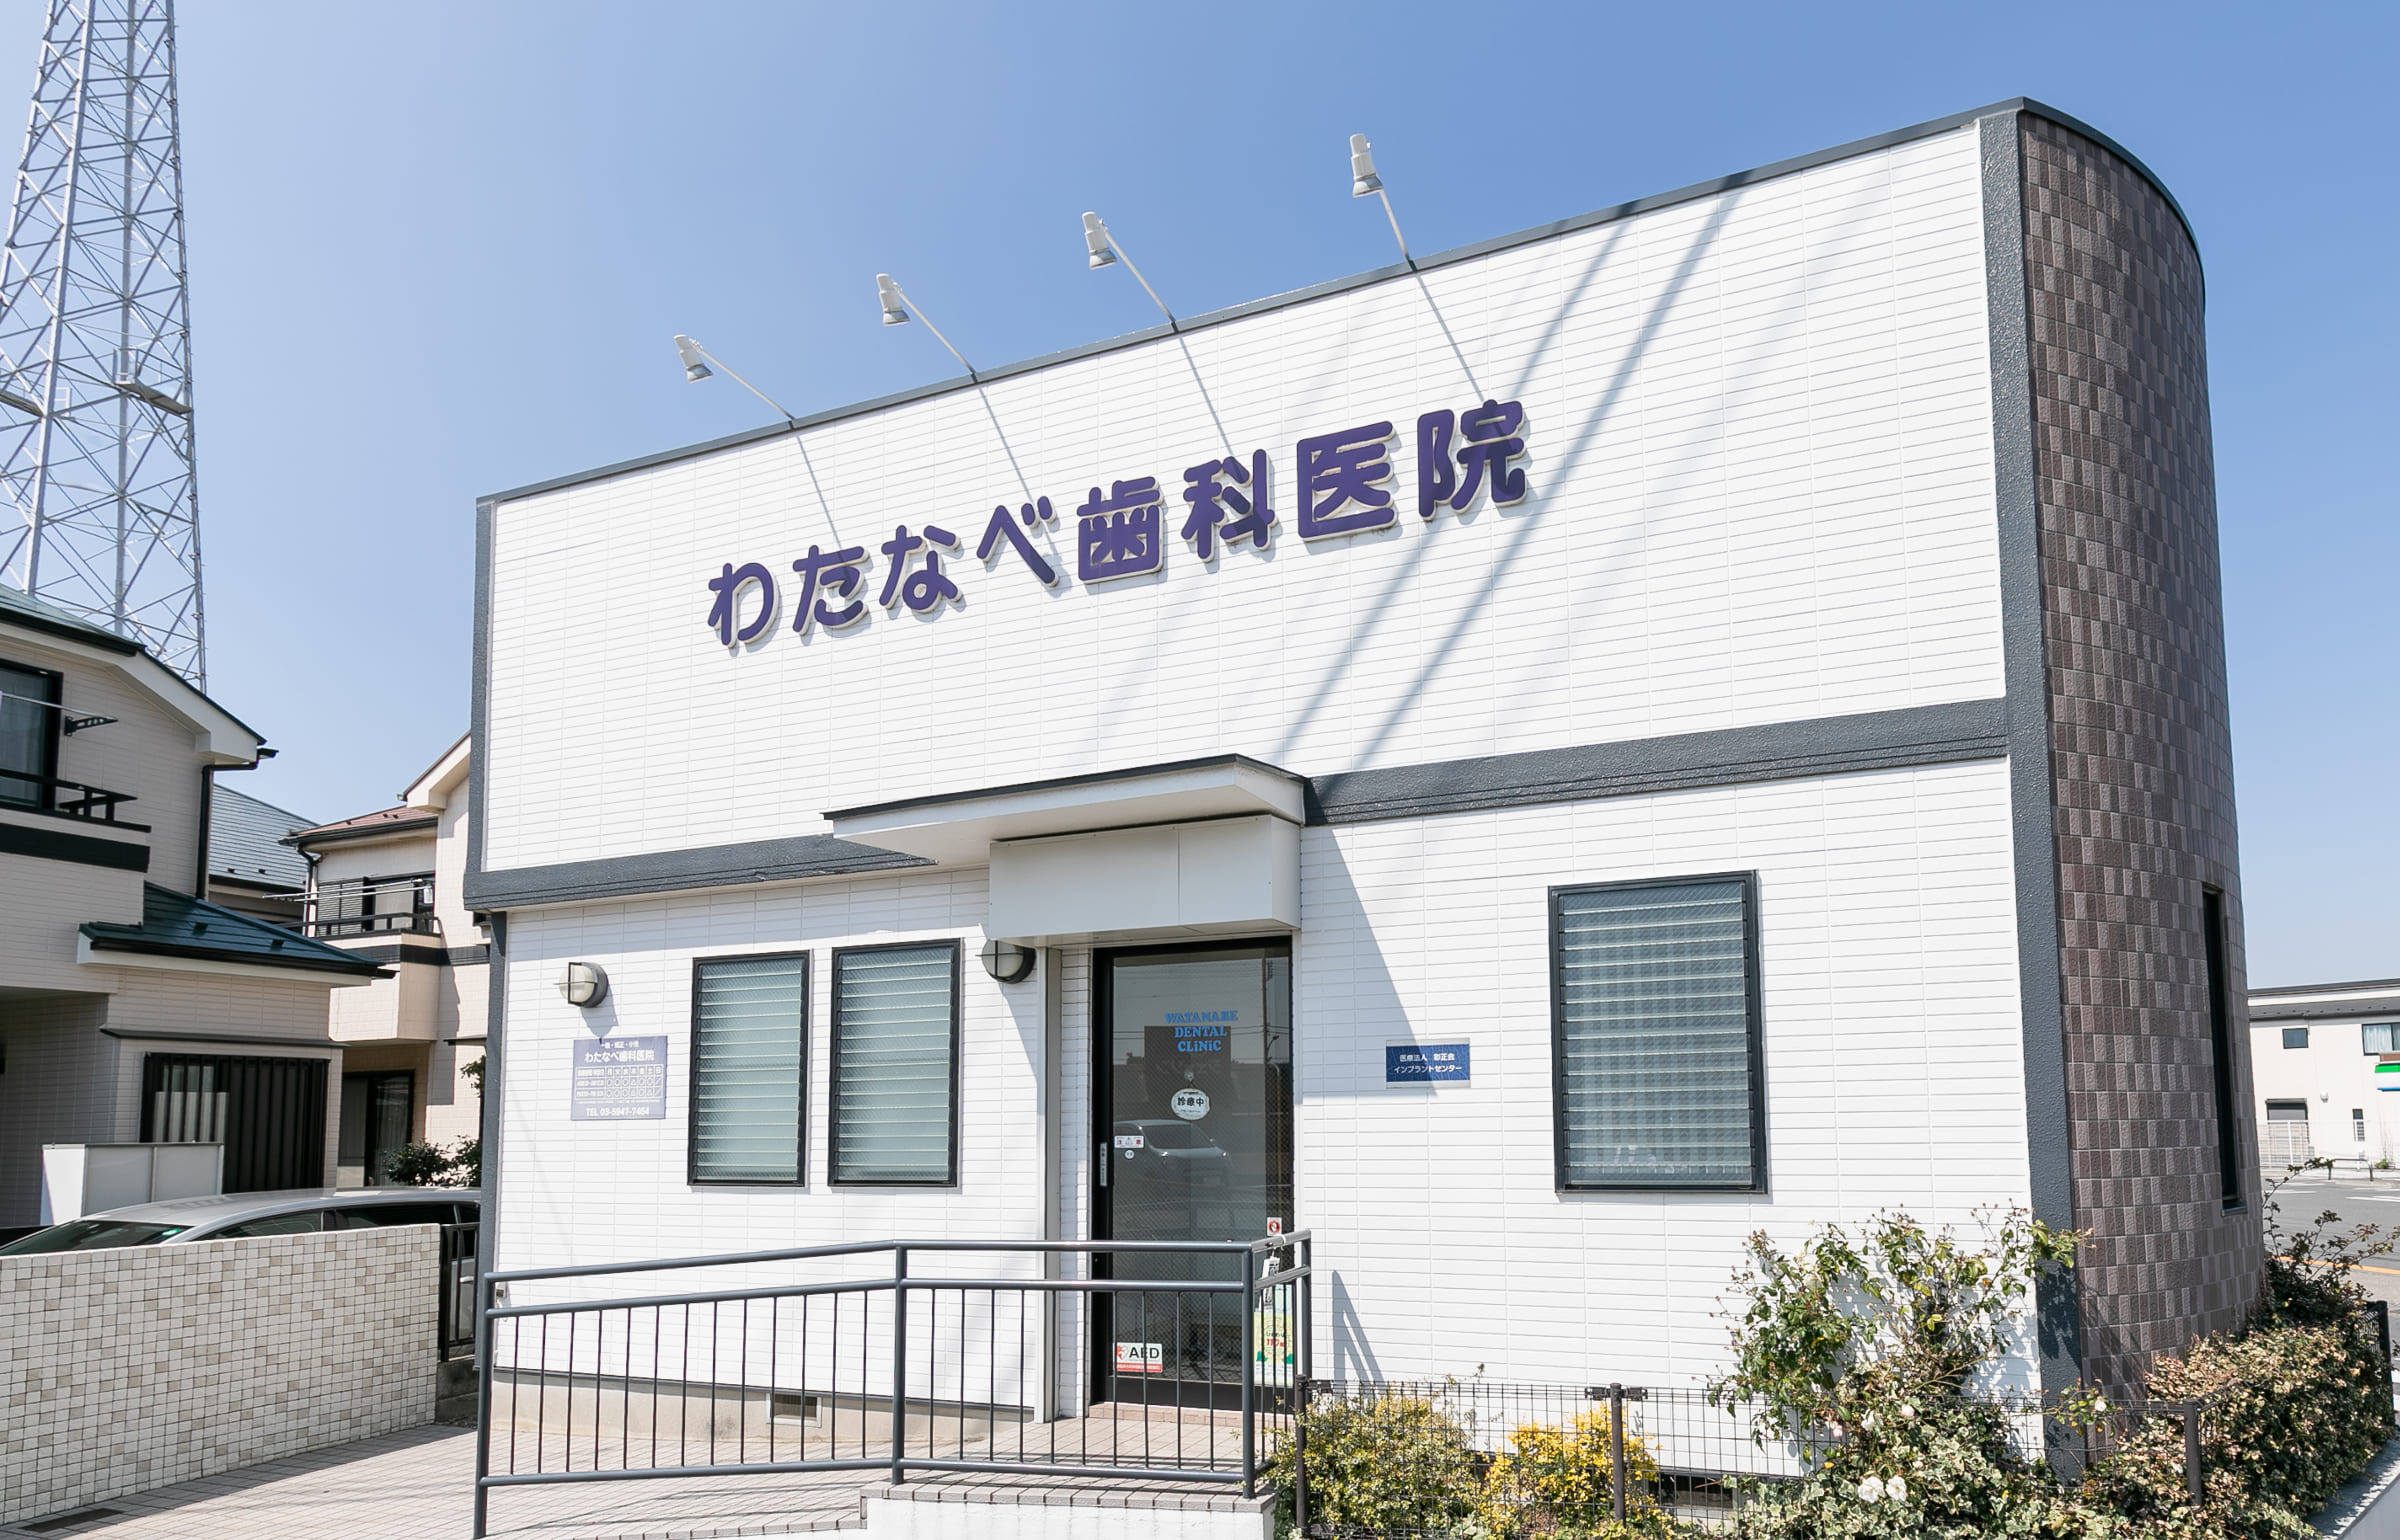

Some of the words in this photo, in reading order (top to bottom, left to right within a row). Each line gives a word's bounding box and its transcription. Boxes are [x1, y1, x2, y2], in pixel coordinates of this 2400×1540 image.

[707, 400, 1526, 648] わたなべ歯科医院
[1164, 1010, 1239, 1024] WATANABE
[1174, 1025, 1227, 1038] DENTAL
[1393, 1065, 1462, 1073] インプラントセンター
[1177, 1096, 1204, 1107] 診療中
[586, 1108, 599, 1117] TEL
[1129, 1346, 1160, 1358] AED
